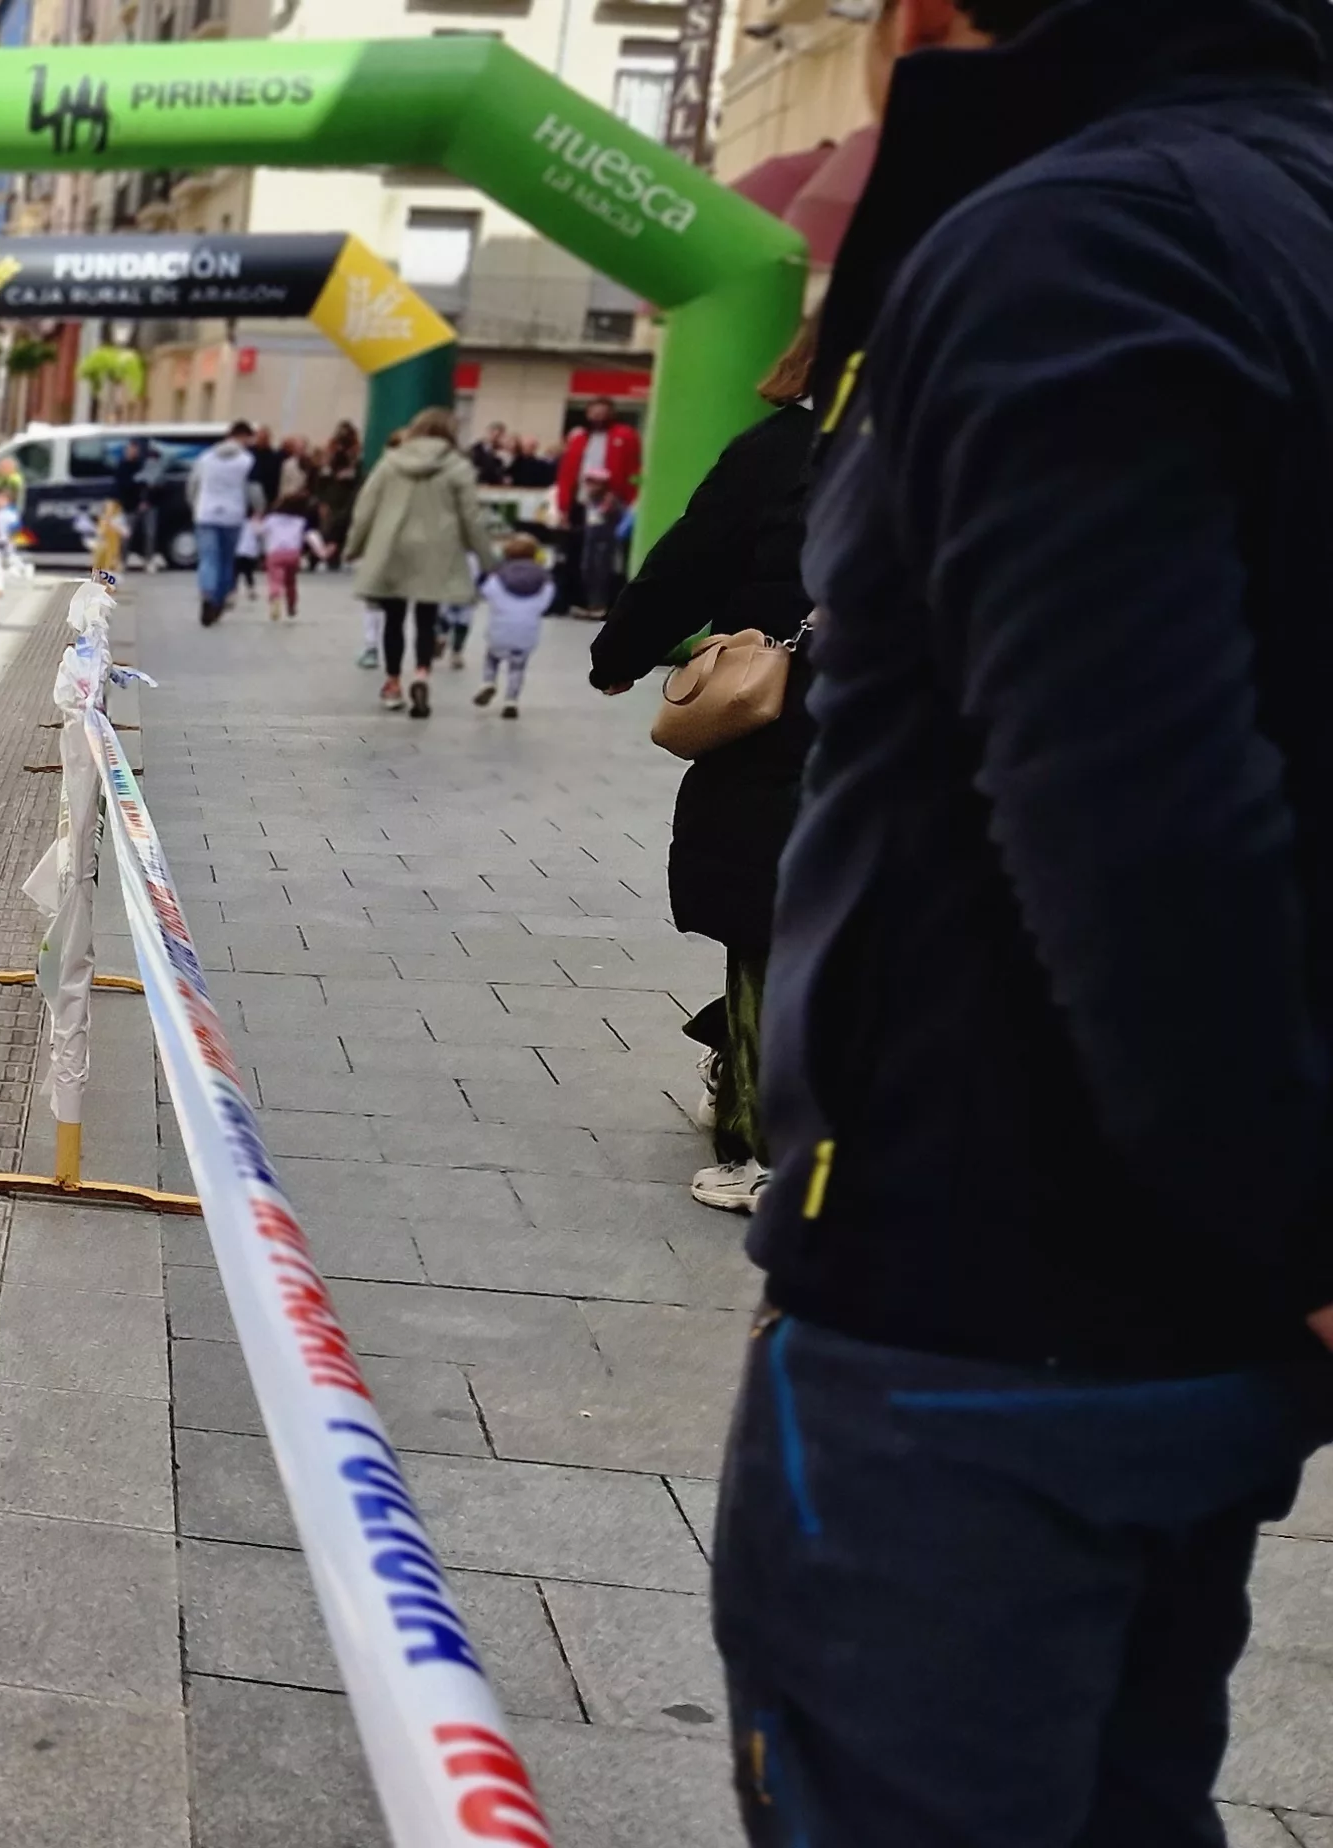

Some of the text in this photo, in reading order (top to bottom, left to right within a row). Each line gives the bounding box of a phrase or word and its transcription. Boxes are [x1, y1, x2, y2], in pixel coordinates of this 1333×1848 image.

[130, 76, 314, 109] PIRINEOS
[53, 246, 242, 281] FUNDACIÓN
[4, 285, 66, 306] CAJA
[69, 285, 142, 306] RURAL
